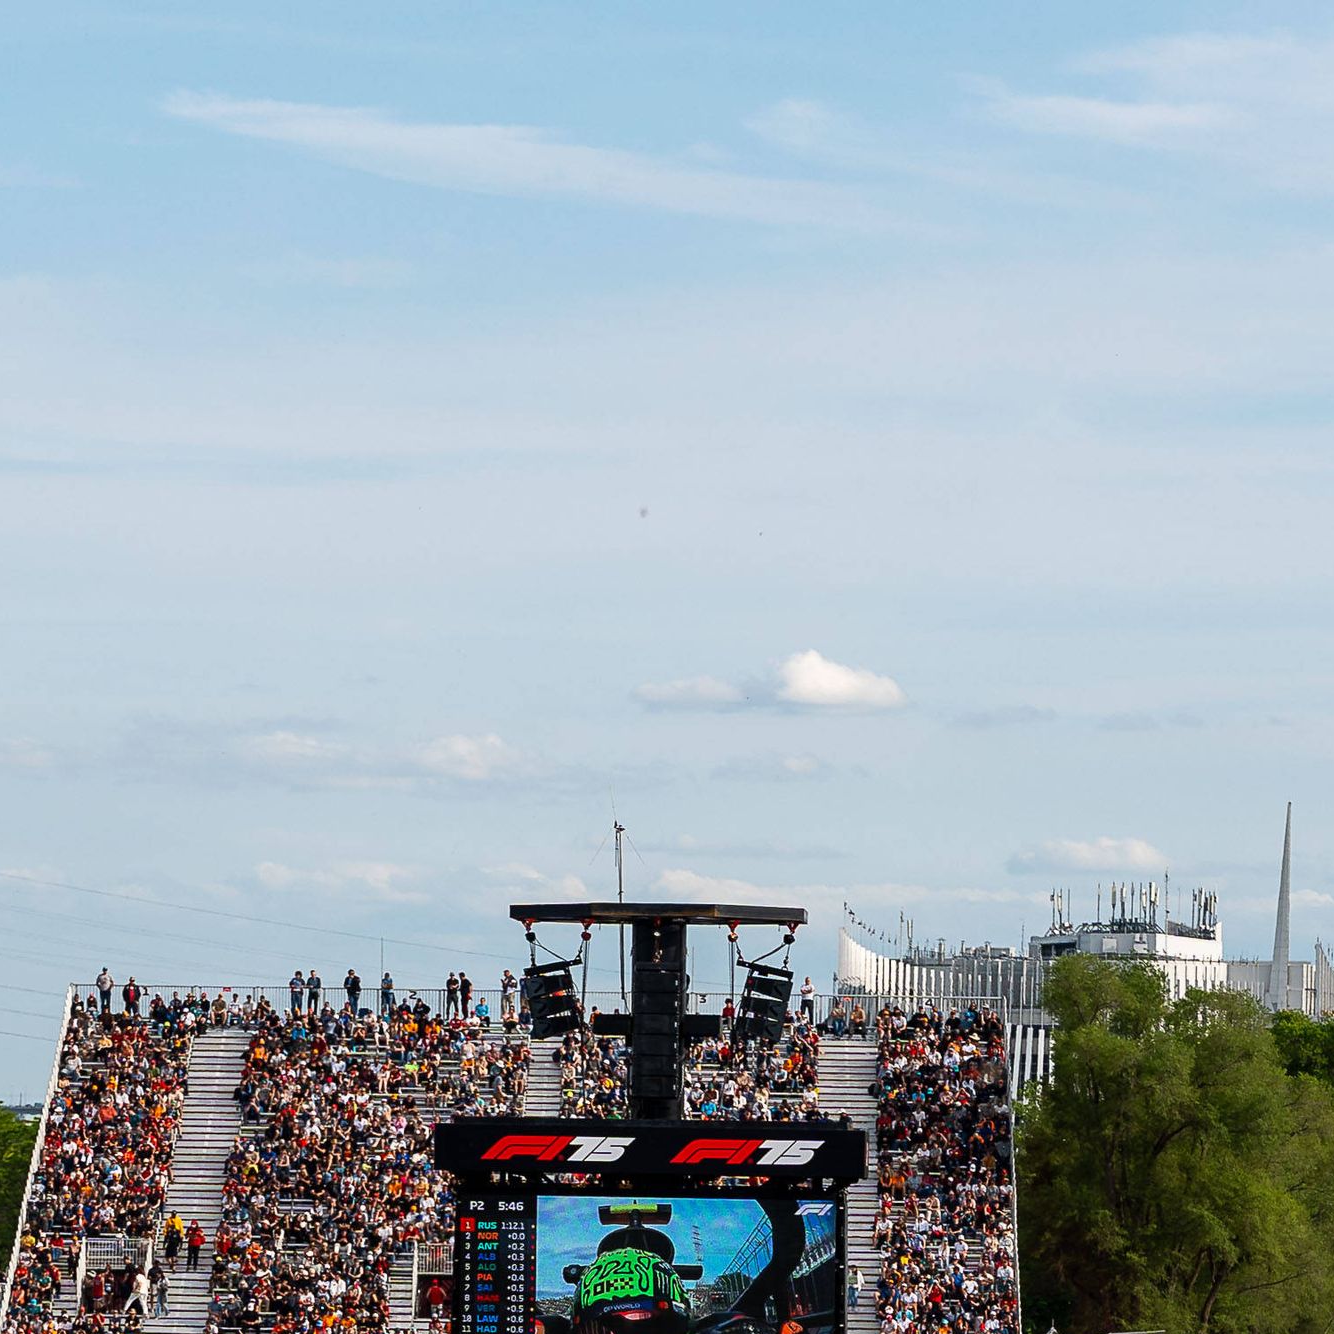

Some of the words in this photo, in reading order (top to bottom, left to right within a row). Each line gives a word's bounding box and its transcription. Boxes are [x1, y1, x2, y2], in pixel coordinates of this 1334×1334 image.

[470, 1201, 485, 1211] P2
[498, 1202, 524, 1211] 5:46
[478, 1222, 497, 1230] RUS
[501, 1222, 525, 1230] 1:12.1
[477, 1232, 499, 1240] NOR
[477, 1242, 499, 1250] ANT
[508, 1243, 525, 1251] +0.2
[507, 1253, 525, 1261] +0.3
[477, 1263, 497, 1271] ALO
[508, 1263, 525, 1271] +0.3
[477, 1273, 493, 1281] PIA
[507, 1273, 525, 1281] +0.4
[507, 1284, 524, 1292] +0.5
[507, 1294, 524, 1302] +0.5
[507, 1304, 524, 1313] +0.5
[476, 1315, 499, 1323] LAW
[507, 1315, 524, 1323] +0.6
[476, 1325, 497, 1333] HAD
[506, 1325, 524, 1334] +0.6
